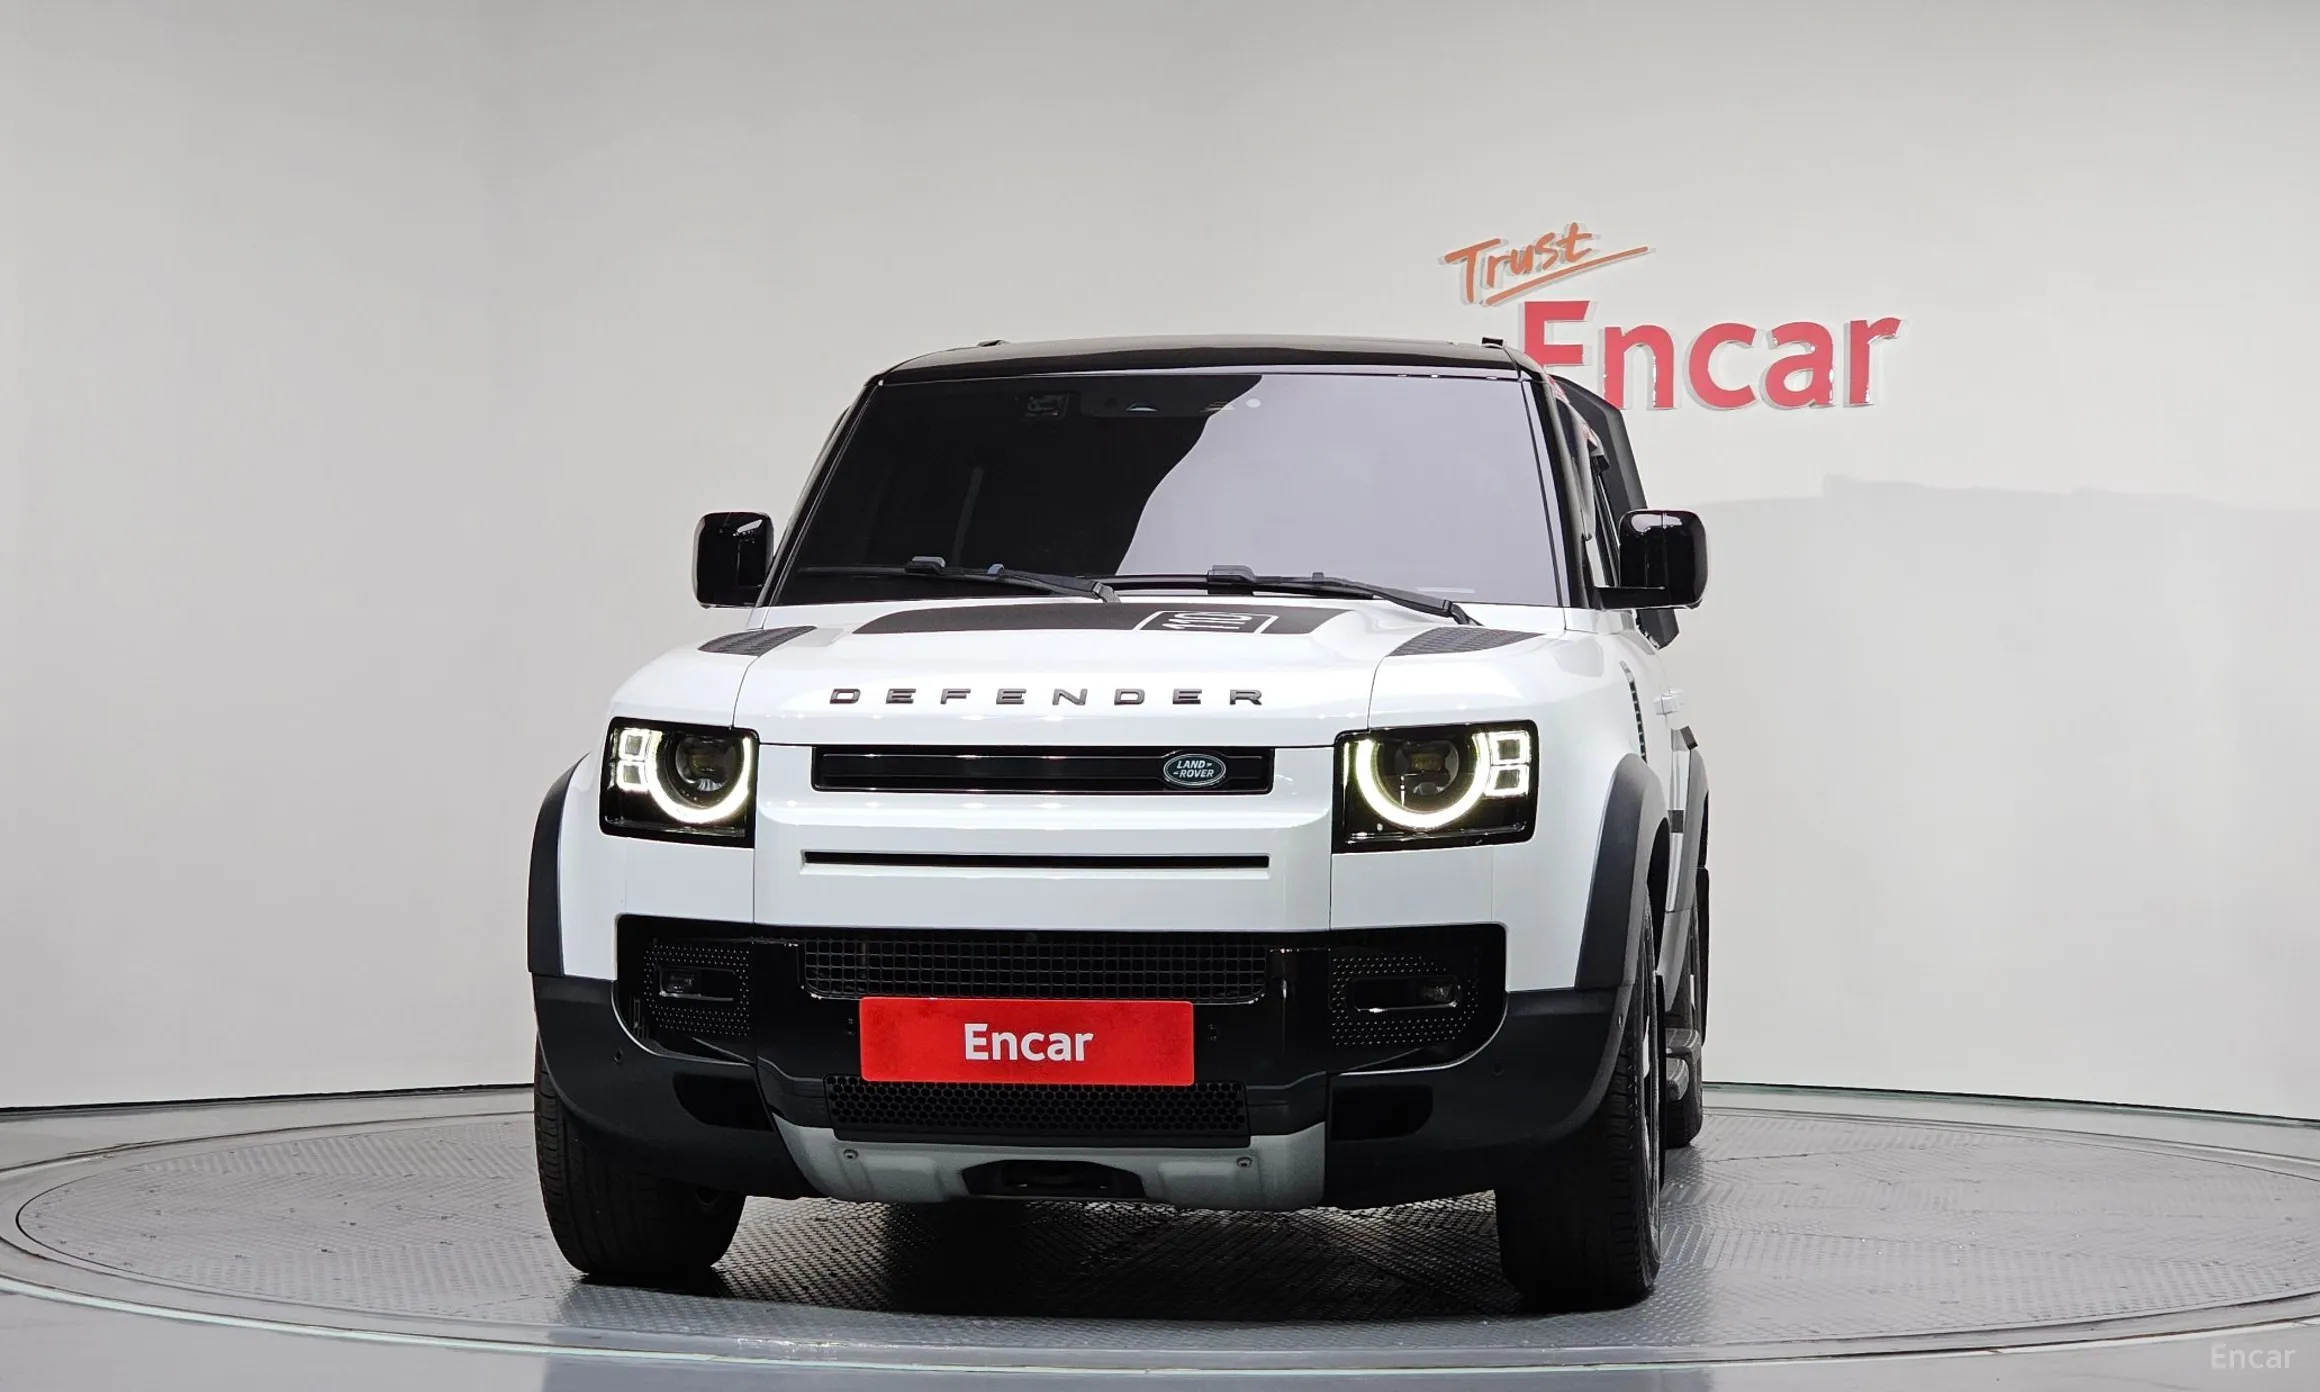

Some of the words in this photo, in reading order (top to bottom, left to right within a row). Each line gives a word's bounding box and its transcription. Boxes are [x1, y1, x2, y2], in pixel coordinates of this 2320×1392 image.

[1444, 222, 1594, 303] Trust
[1523, 300, 1902, 410] Encar
[829, 687, 1263, 706] DEFENDER
[963, 1022, 1095, 1062] Encar
